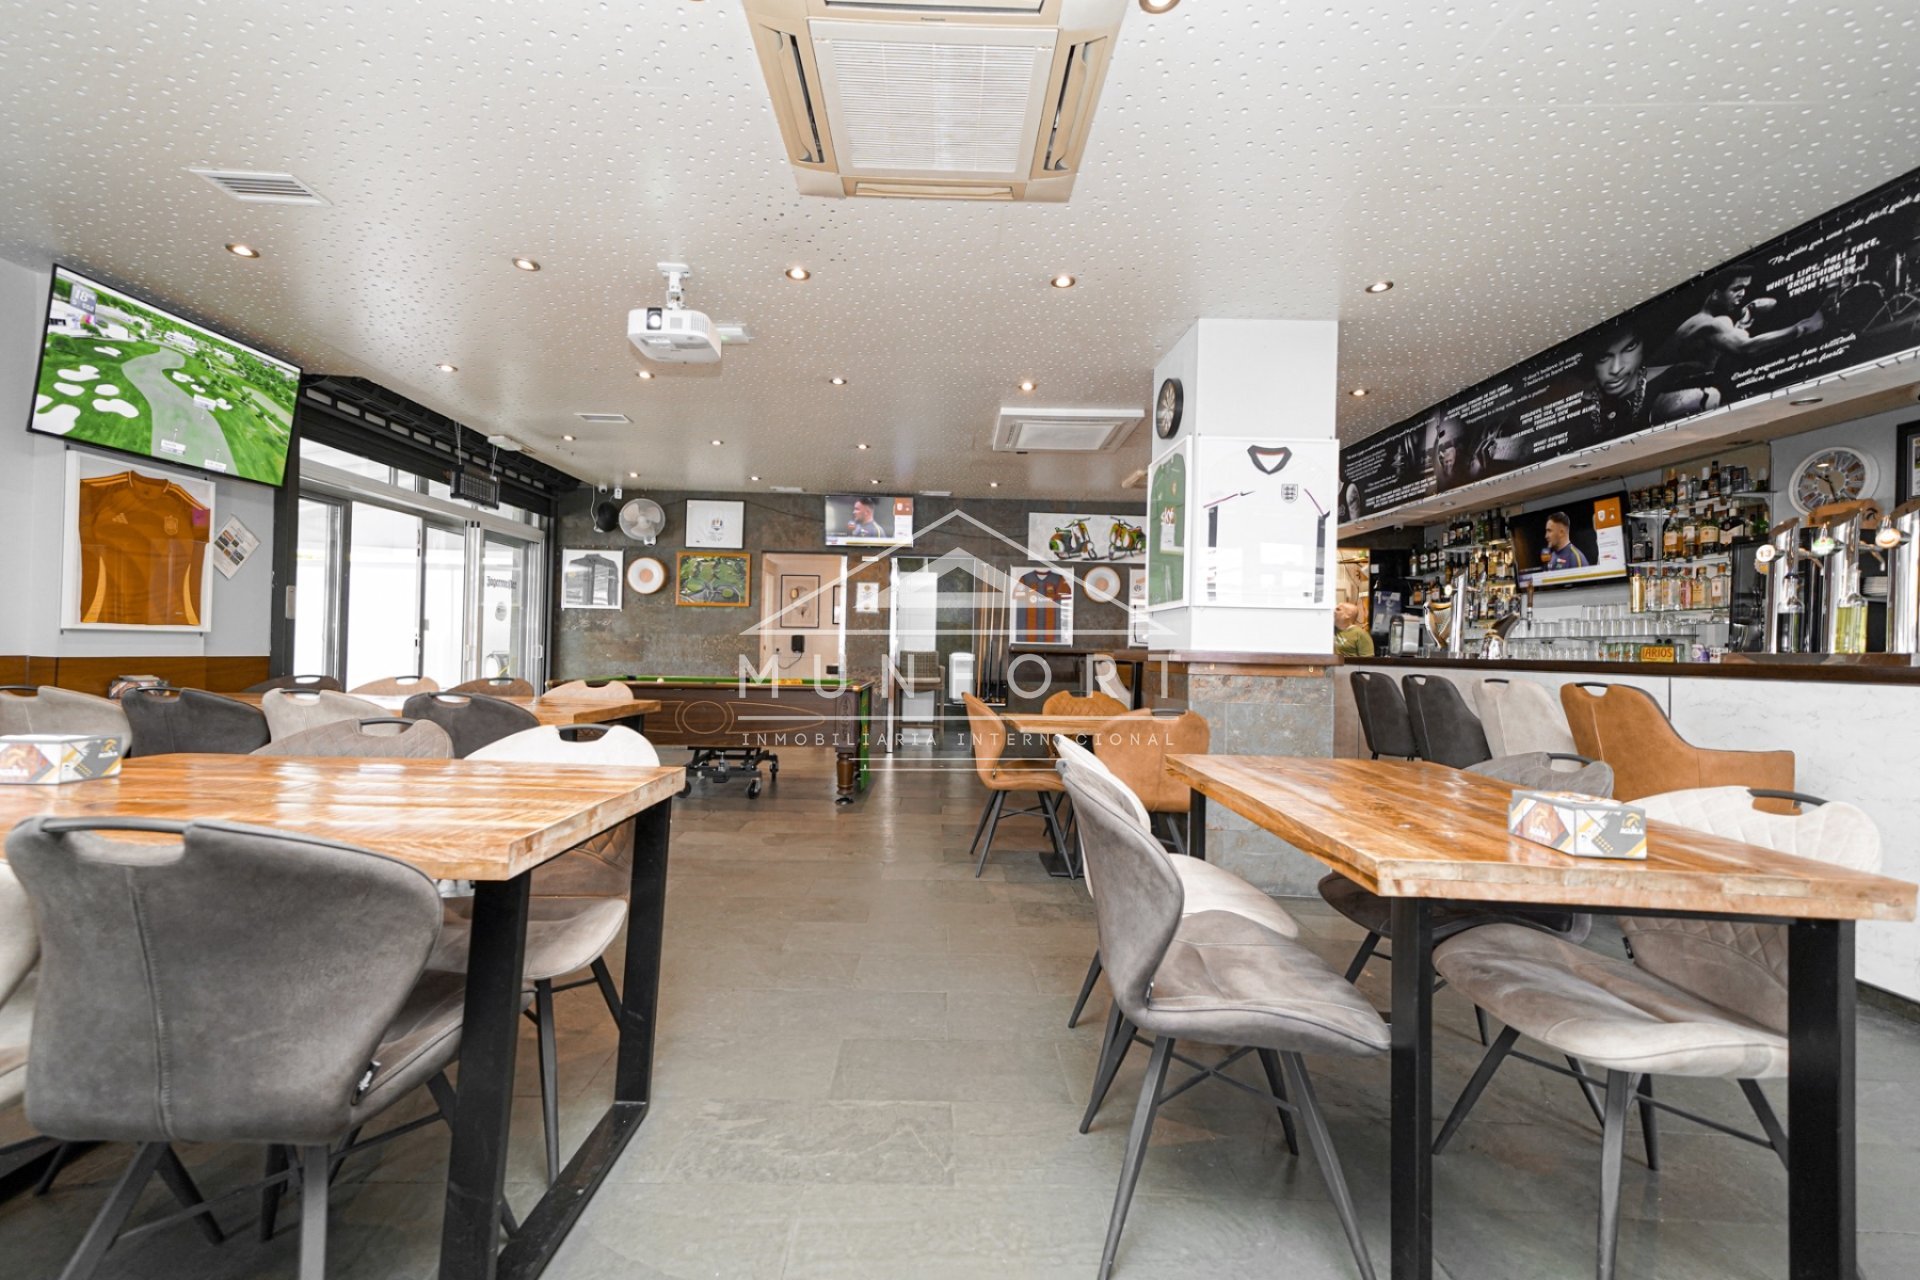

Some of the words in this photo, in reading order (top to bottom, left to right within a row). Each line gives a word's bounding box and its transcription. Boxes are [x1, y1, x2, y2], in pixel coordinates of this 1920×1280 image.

[1766, 275, 1795, 291] WHITE
[1823, 249, 1848, 266] PALE
[1786, 262, 1842, 290] BREATHING
[1844, 255, 1858, 269] IN
[1788, 282, 1817, 298] SNOW
